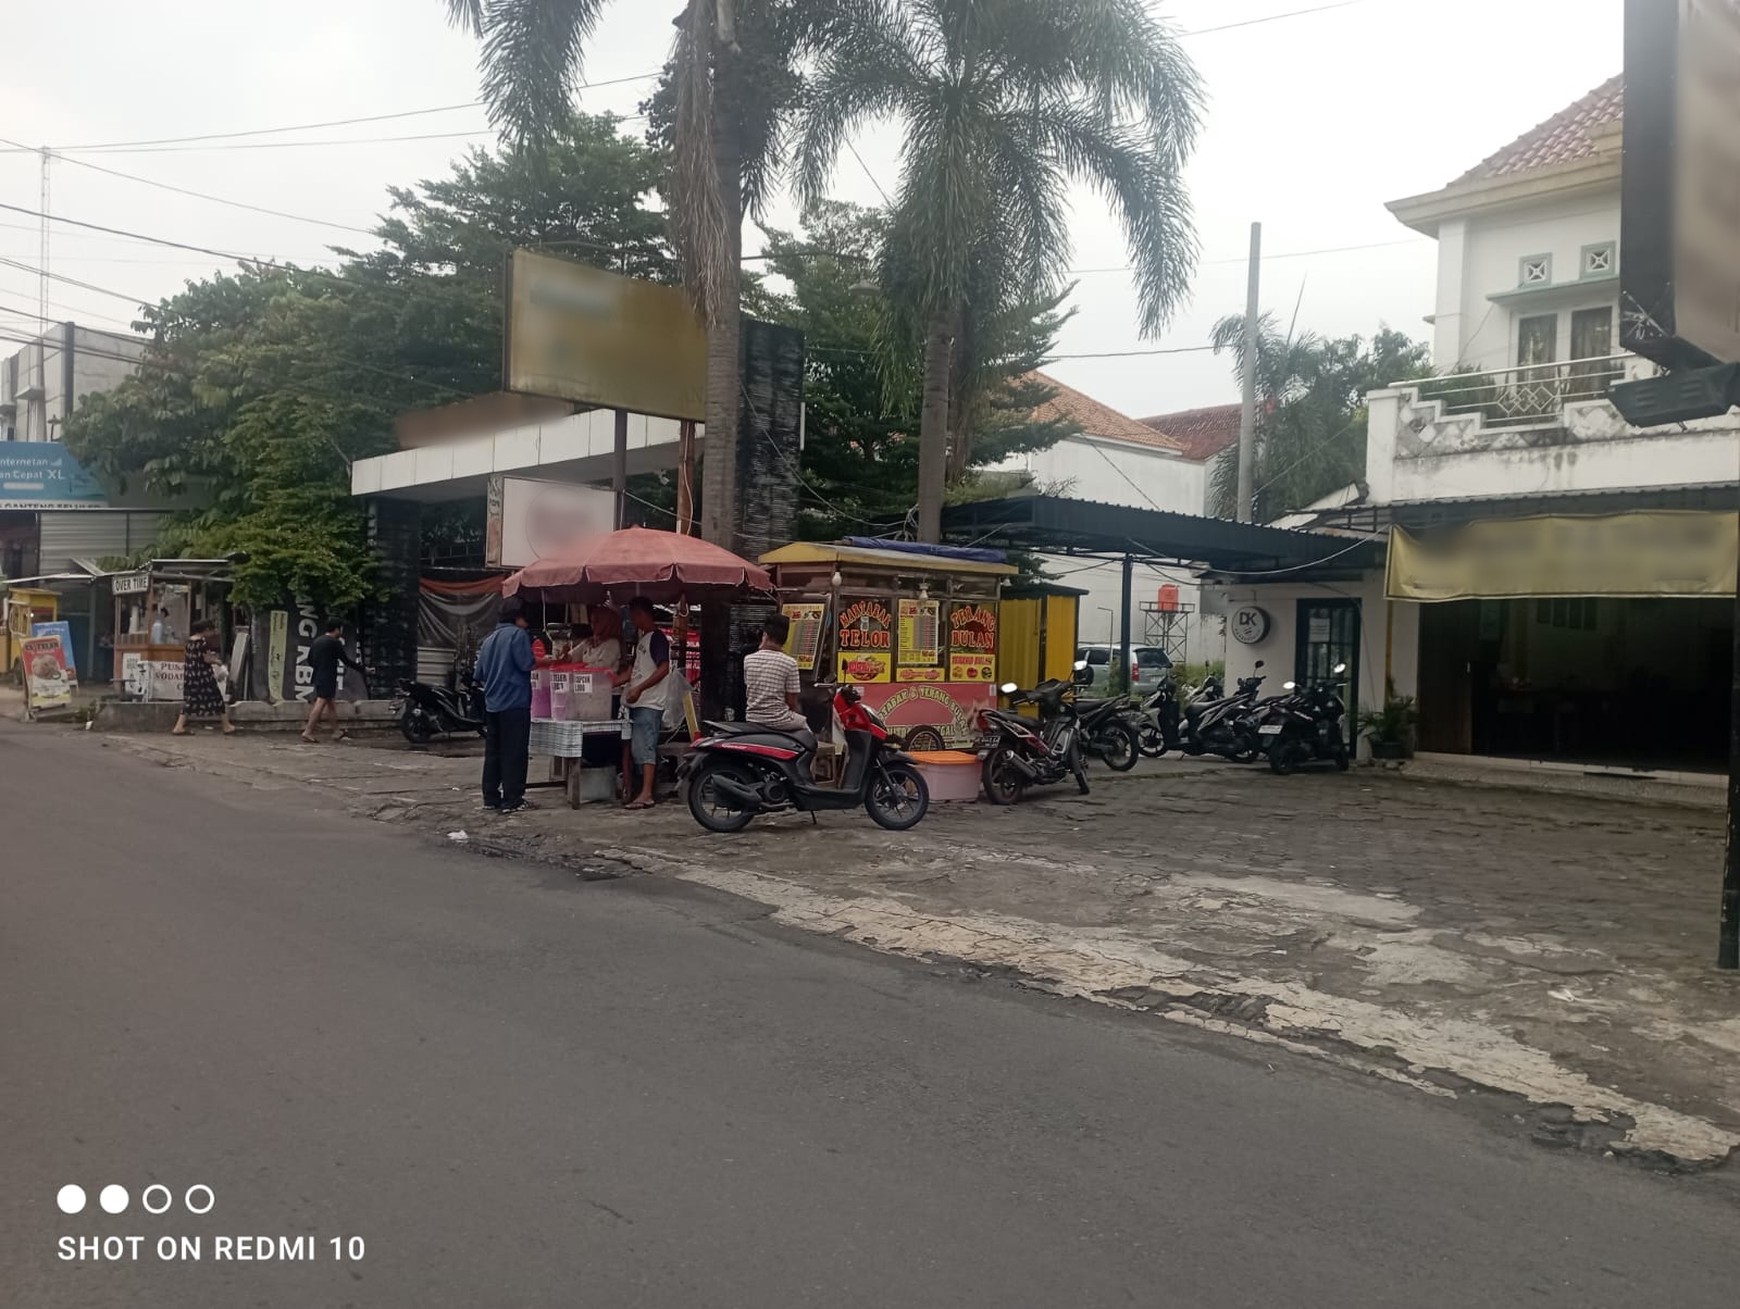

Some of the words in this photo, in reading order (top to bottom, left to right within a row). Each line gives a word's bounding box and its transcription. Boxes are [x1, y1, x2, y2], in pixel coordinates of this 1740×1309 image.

[47, 469, 66, 480] XL
[115, 578, 131, 592] OVER
[133, 576, 148, 590] TIME
[839, 601, 892, 629] MARTABAK
[951, 607, 995, 631] TERANG
[839, 629, 891, 648] TELOR
[951, 630, 995, 649] BULAN
[920, 687, 949, 705] TERANG
